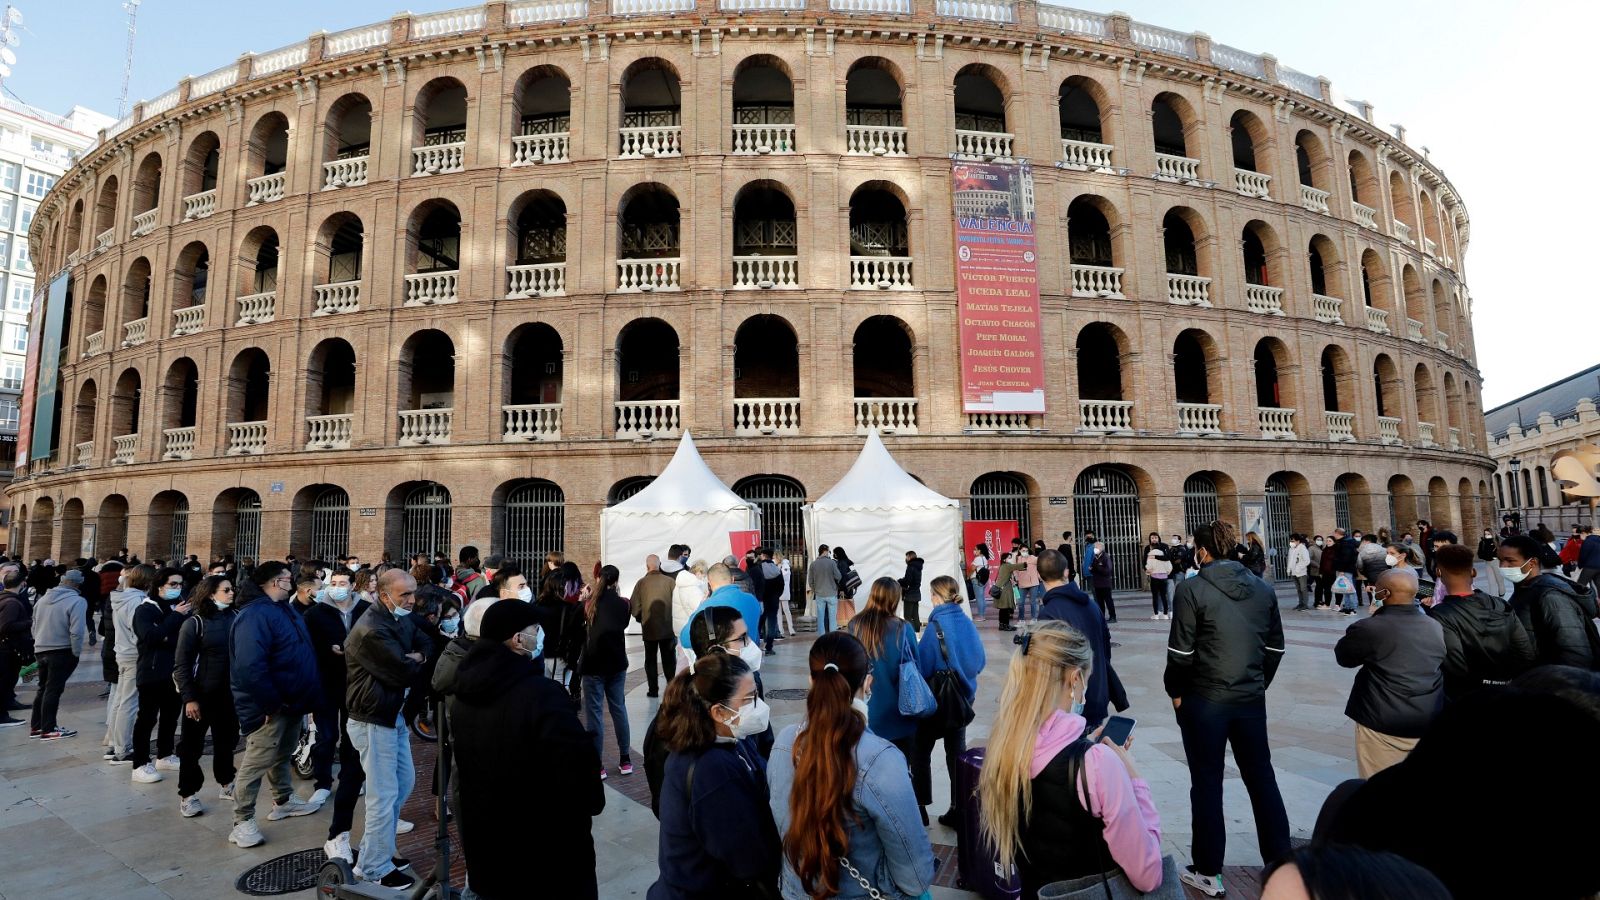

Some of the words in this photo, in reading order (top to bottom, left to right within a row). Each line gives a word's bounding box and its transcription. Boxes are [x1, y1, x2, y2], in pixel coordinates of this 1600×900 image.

[959, 217, 1032, 233] VALENCIA
[999, 274, 1036, 283] PUERTO
[969, 287, 1002, 296] UCEDA
[1005, 289, 1031, 297] LEAL
[1001, 304, 1033, 313] TEJELA
[964, 318, 1000, 327] OCTAVIO
[976, 333, 998, 341] PEPE
[1000, 334, 1028, 342] MORAL
[1000, 365, 1032, 373] CHOVER
